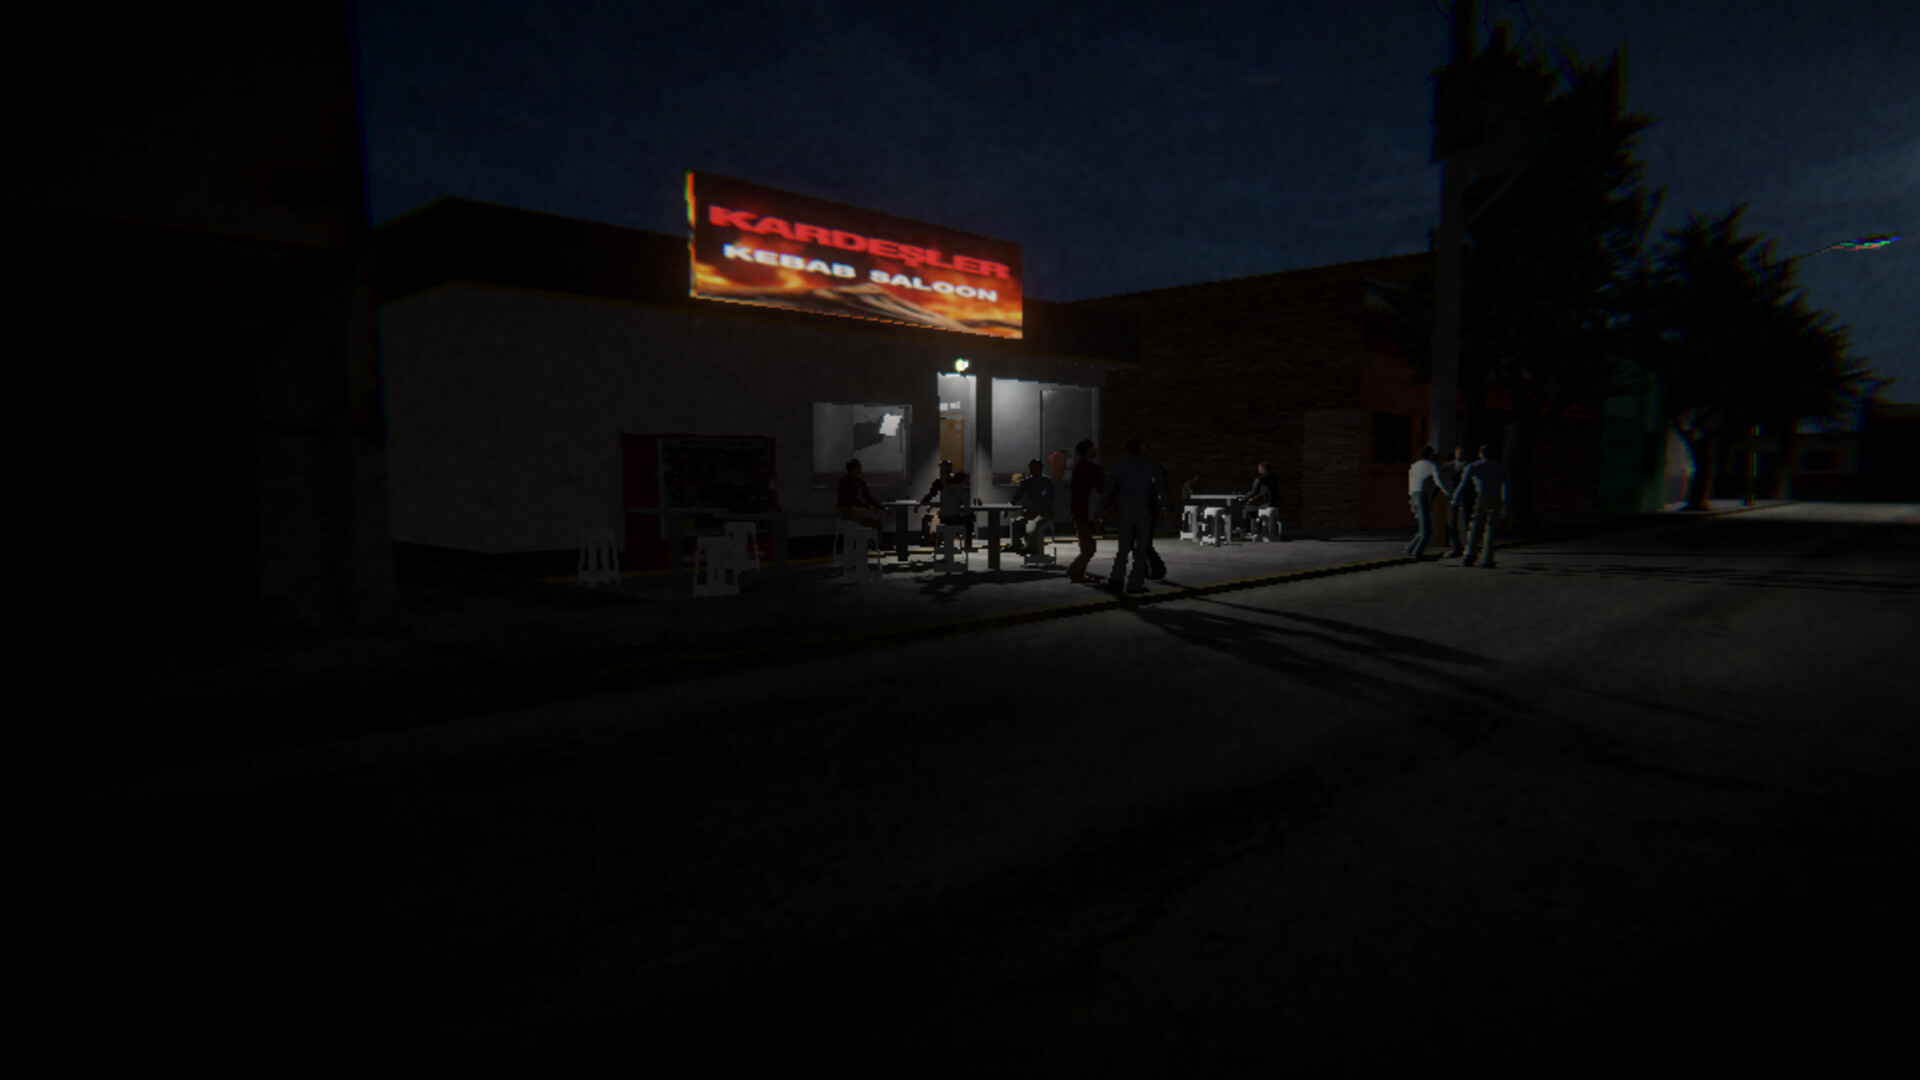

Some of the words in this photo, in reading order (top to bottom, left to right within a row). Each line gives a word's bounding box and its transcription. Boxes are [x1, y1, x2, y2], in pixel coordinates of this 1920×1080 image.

[709, 205, 1010, 279] KARDEŞLER
[724, 244, 856, 278] KEBAB
[869, 269, 998, 302] SALOON
